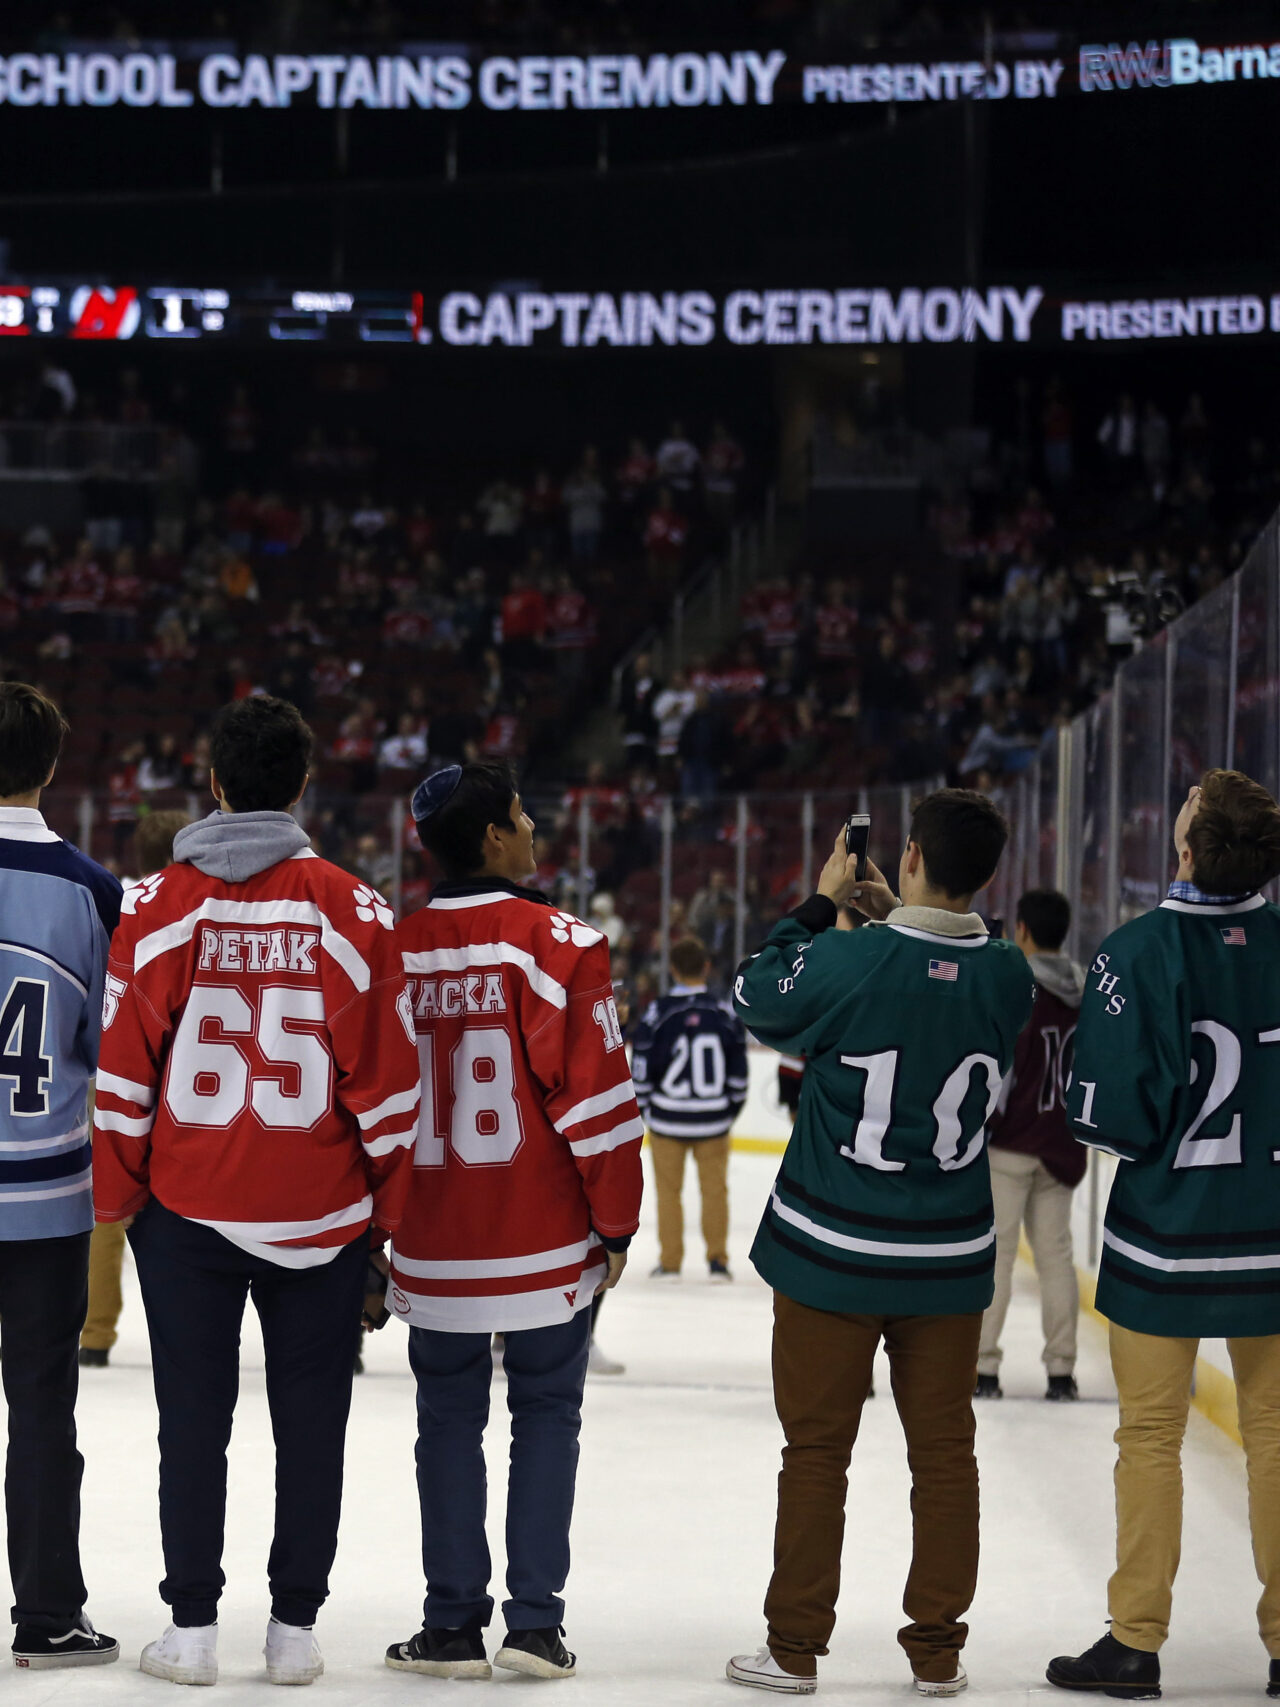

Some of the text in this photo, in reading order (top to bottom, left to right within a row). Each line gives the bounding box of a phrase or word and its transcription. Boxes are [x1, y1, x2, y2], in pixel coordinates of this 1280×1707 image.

[199, 53, 471, 109] CAPTAINS
[478, 49, 787, 110] CEREMONY
[803, 62, 1010, 104] PRESENTED
[1015, 60, 1063, 99] BY
[162, 293, 185, 332] 1
[439, 290, 716, 347] CAPTAINS
[723, 285, 1044, 345] CEREMONY
[1061, 294, 1265, 341] PRESENTED
[198, 930, 318, 973] PETAK
[1091, 953, 1126, 1015] SHS
[164, 981, 334, 1133] 65
[660, 1032, 727, 1098] 20
[412, 1024, 526, 1169] 18
[839, 1050, 1003, 1172] 10
[1172, 1019, 1280, 1170] 2
